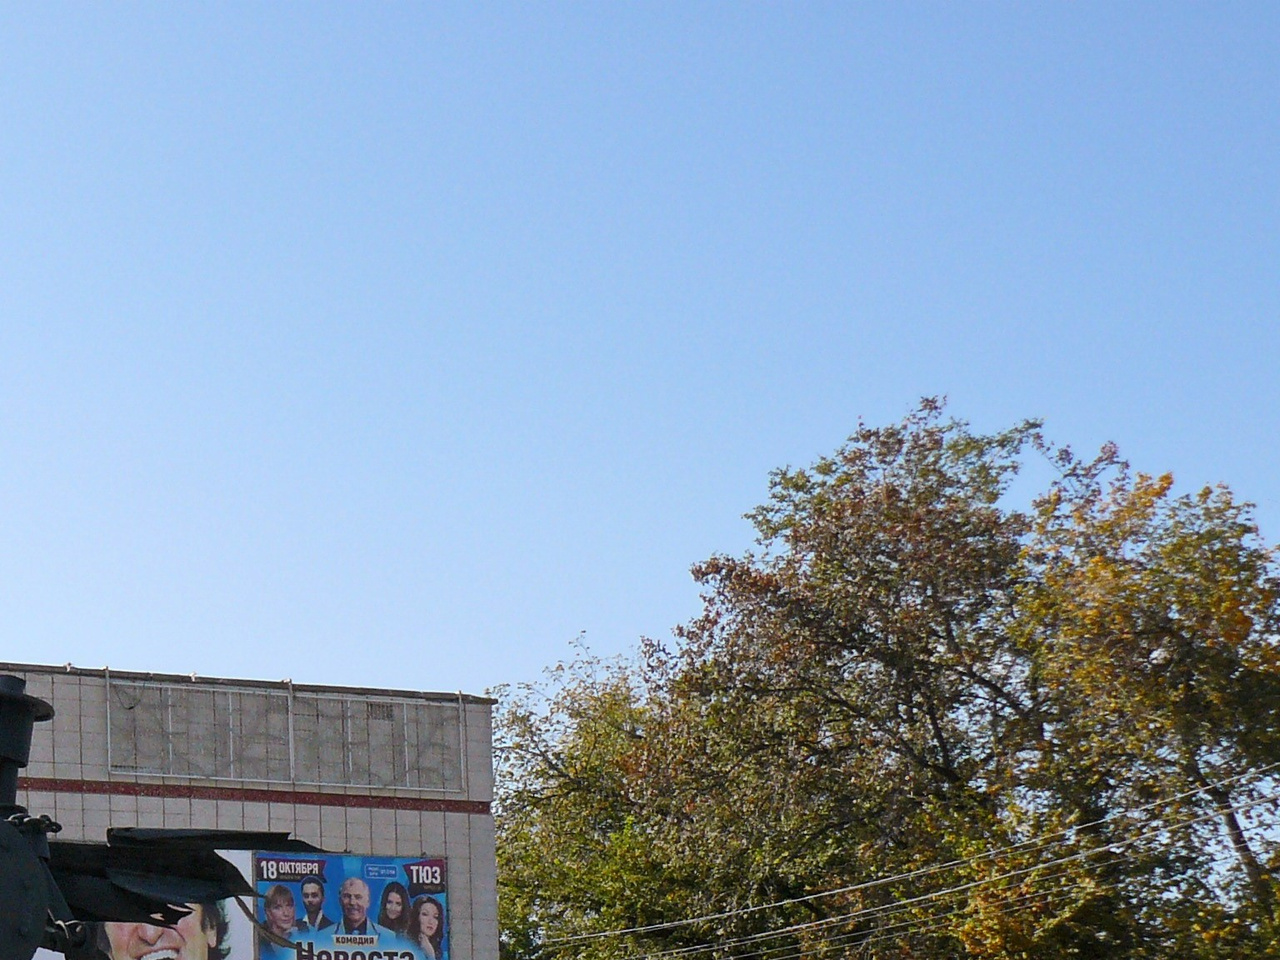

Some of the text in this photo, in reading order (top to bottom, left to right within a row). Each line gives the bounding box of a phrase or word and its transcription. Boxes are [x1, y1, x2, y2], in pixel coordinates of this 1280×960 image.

[260, 860, 319, 879] 18 ОКТЯБРЯ
[410, 865, 441, 884] ТЮЗ
